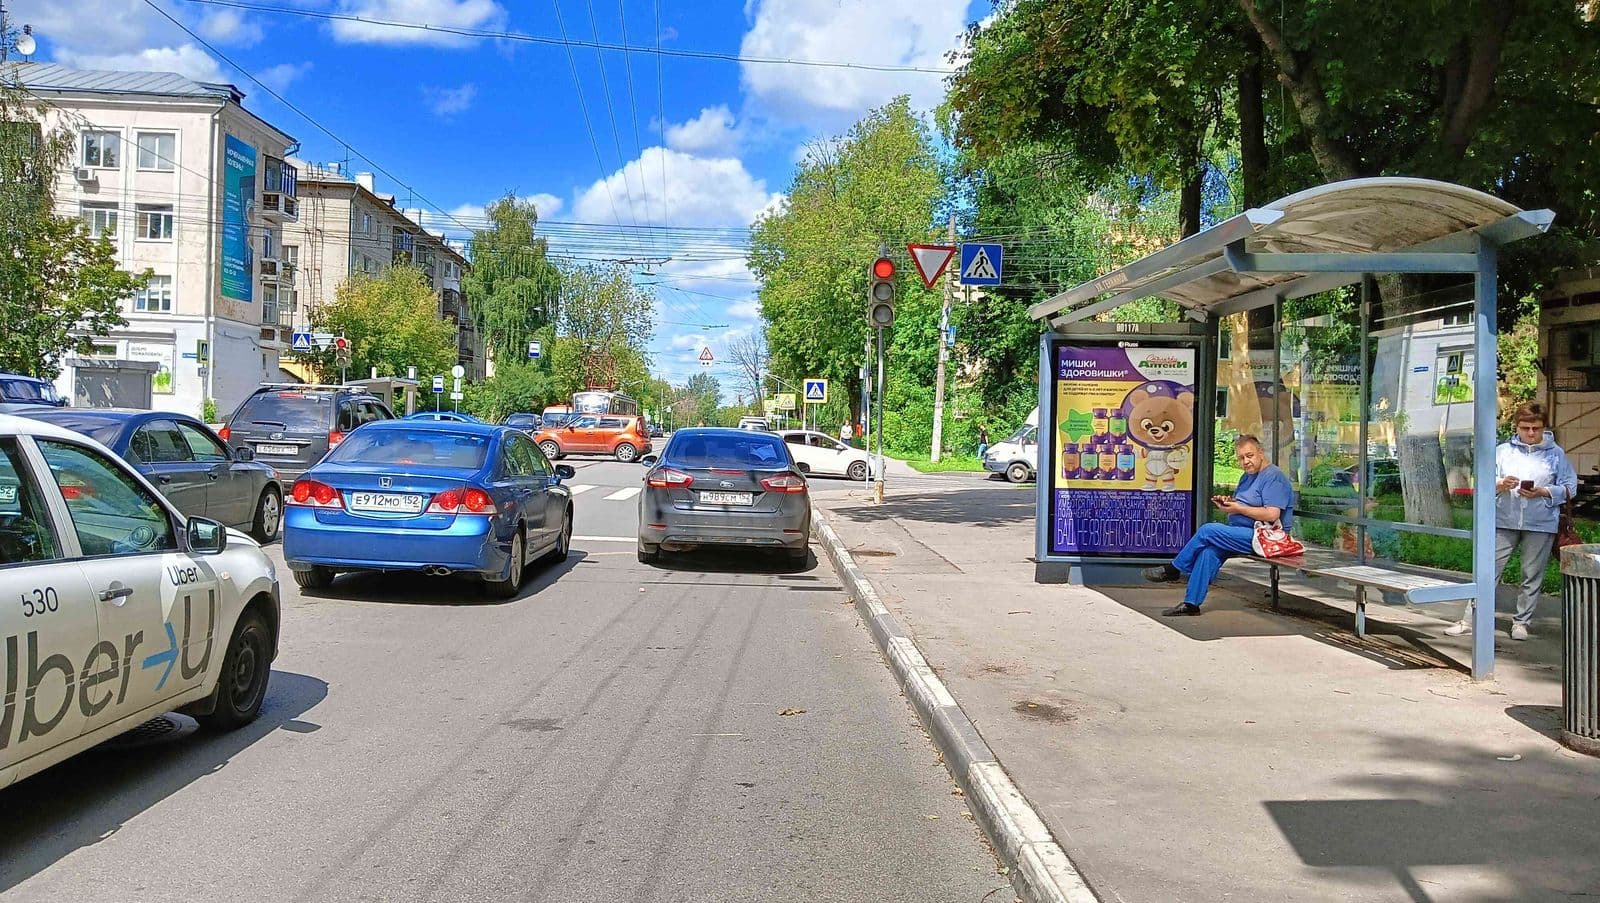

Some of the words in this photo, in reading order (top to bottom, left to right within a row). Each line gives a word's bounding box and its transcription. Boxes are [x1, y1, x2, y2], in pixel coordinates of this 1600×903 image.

[1061, 360, 1097, 368] МИШКИ
[404, 495, 418, 505] 152
[167, 565, 199, 587] Uber
